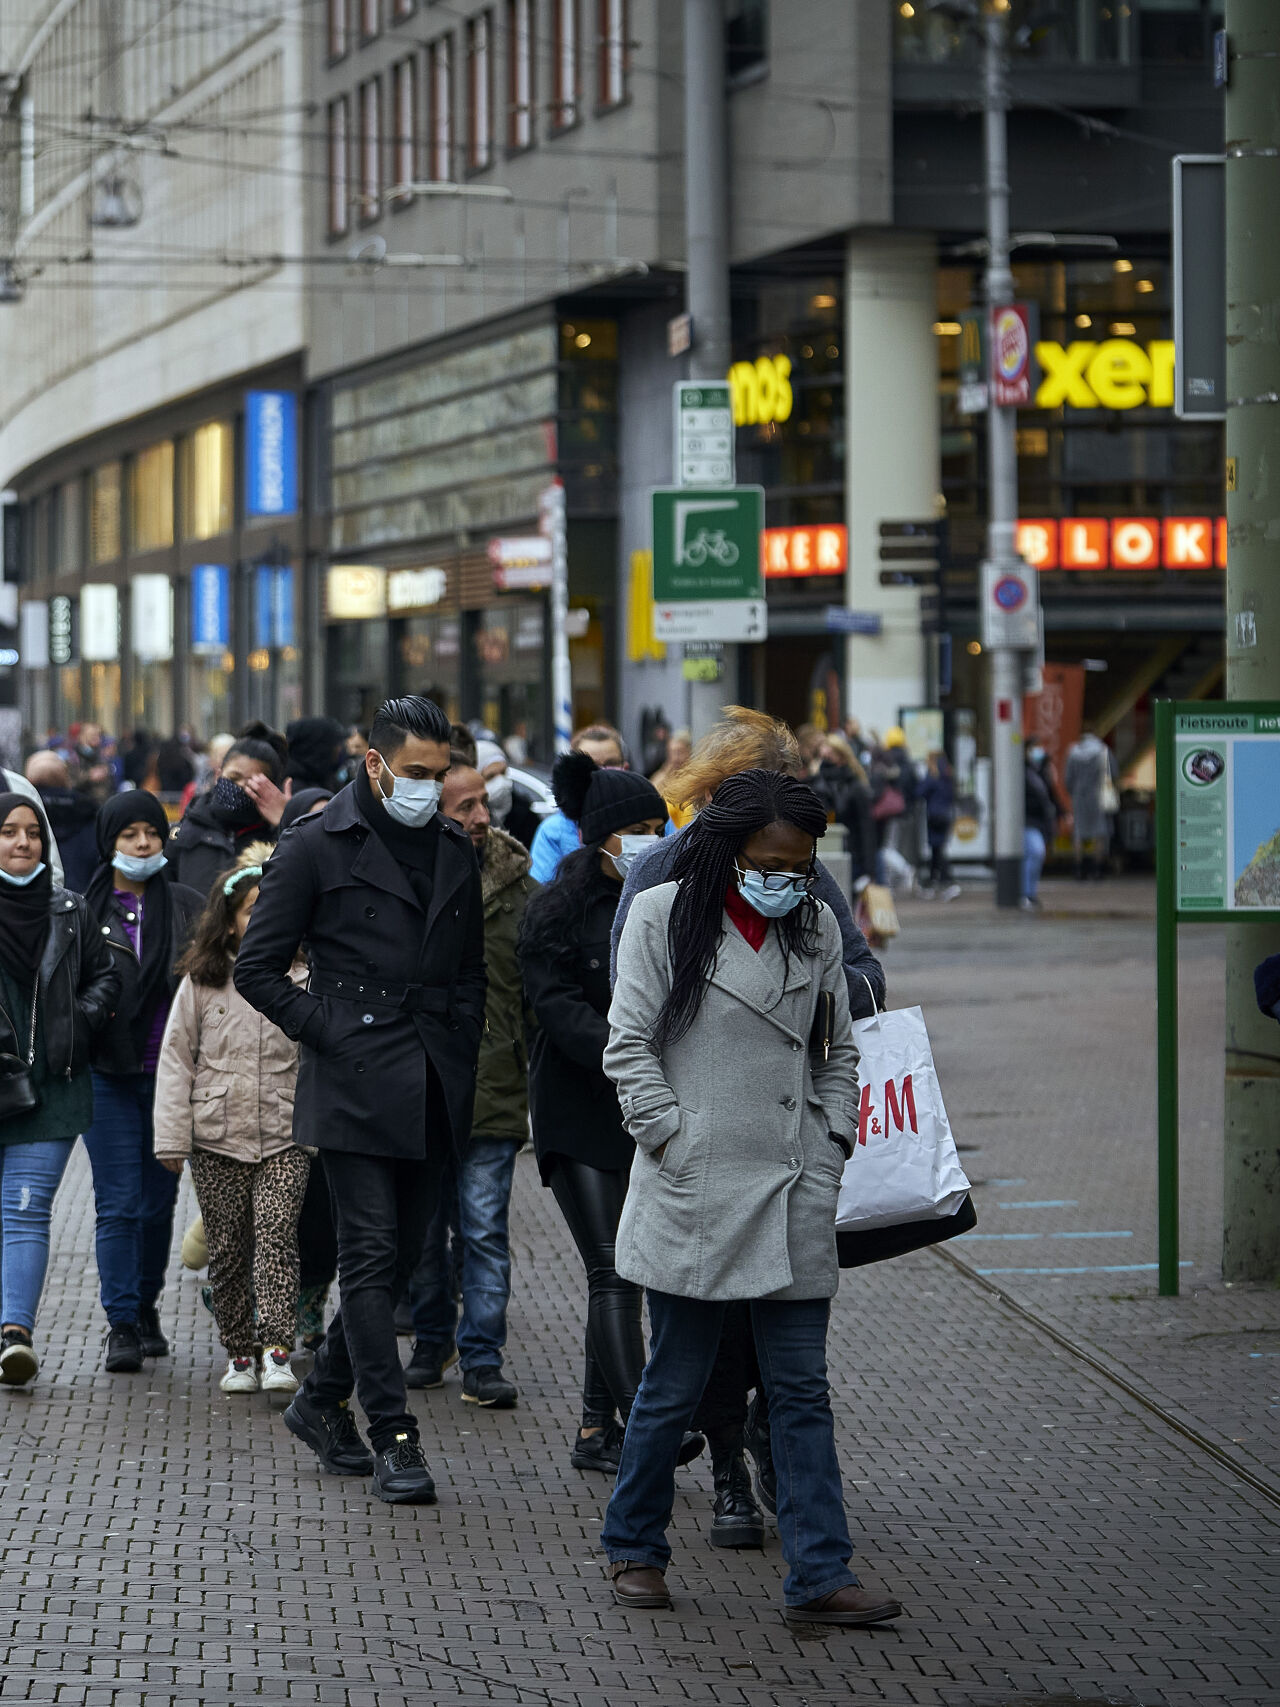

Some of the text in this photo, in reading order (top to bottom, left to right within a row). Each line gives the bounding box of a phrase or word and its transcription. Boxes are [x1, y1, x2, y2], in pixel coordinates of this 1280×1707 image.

[768, 529, 841, 572] KER
[1017, 522, 1207, 564] BLOK
[1180, 715, 1249, 730] Fietsroute
[857, 1074, 918, 1146] H&M
